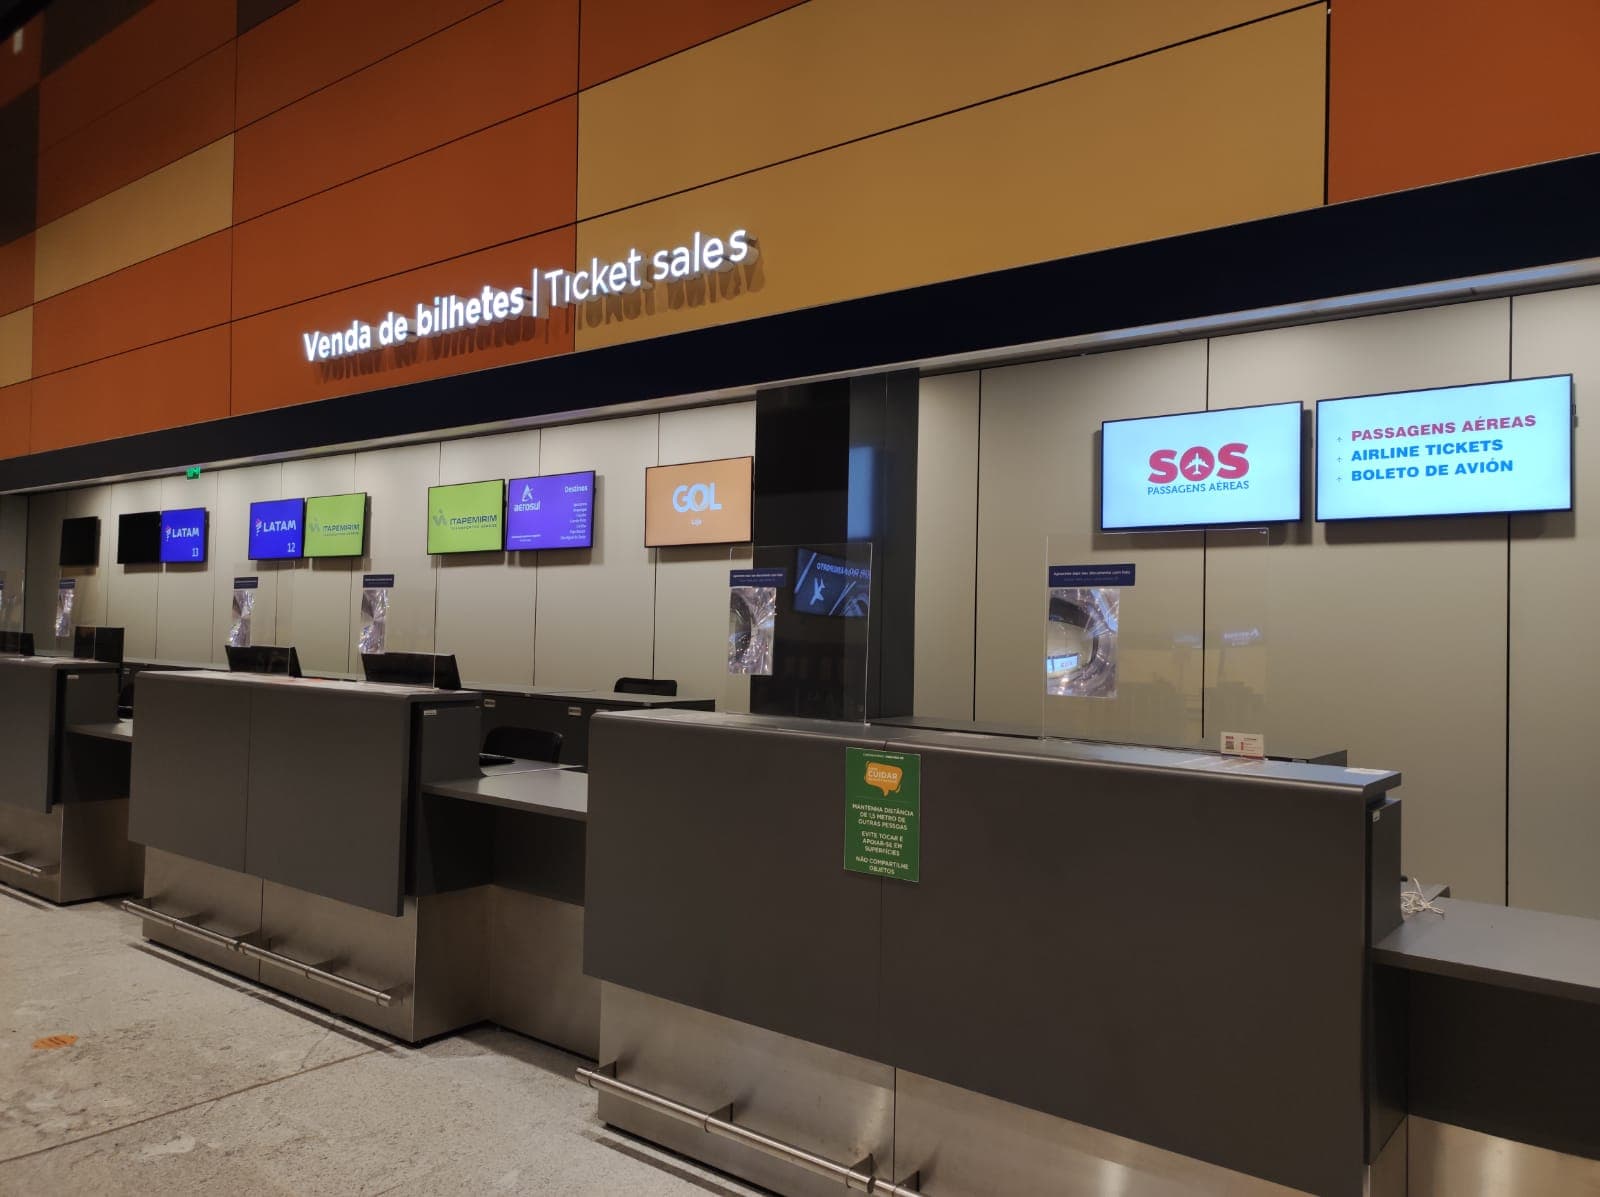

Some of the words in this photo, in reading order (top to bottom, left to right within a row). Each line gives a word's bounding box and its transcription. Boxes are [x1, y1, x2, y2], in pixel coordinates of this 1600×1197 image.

[544, 248, 642, 306] Ticket
[653, 229, 748, 280] sales
[303, 320, 371, 361] Venda
[379, 312, 408, 345] de
[416, 285, 525, 337] bilhetes
[1351, 422, 1456, 441] PASSAGENS
[1461, 415, 1536, 433] AÉREAS
[1351, 445, 1420, 461] AIRLINE
[1425, 439, 1503, 456] TICKETS
[1148, 443, 1250, 485] SOS
[1351, 466, 1419, 481] BOLETO
[1425, 464, 1449, 477] DE
[1455, 458, 1513, 475] AVIÓN
[1147, 483, 1206, 495] PASSAGENS
[1209, 480, 1250, 492] AÉREAS
[673, 482, 722, 512] GOL
[263, 520, 296, 532] LATAM
[449, 515, 497, 525] ITAPEMIRIM
[172, 528, 200, 538] LATAM
[287, 542, 296, 553] 12
[868, 770, 897, 780] CUIDAR
[852, 804, 883, 812] MANTENHA
[884, 807, 914, 816] DISTÂNCIA
[858, 818, 880, 827] OUTRAS
[882, 822, 907, 830] PESSOAS
[861, 830, 877, 838] EVITE
[862, 838, 892, 848] APOIAR-SE
[865, 846, 899, 856] SUPERFÍCIES
[869, 859, 908, 869] COMPARTILHE
[869, 865, 895, 875] OBJETOS
